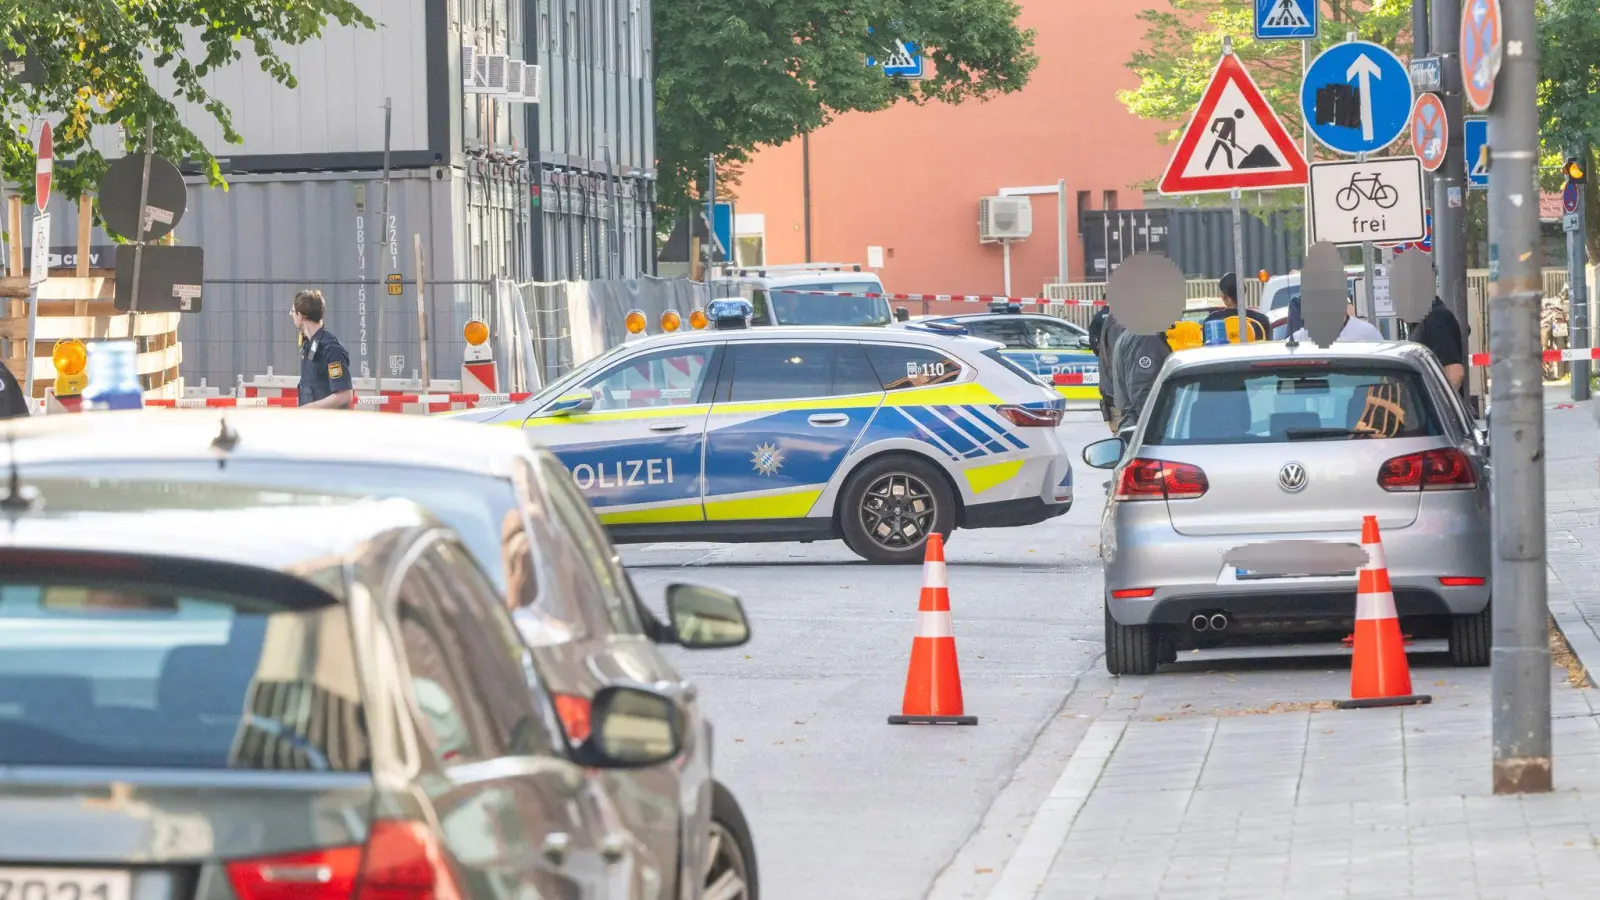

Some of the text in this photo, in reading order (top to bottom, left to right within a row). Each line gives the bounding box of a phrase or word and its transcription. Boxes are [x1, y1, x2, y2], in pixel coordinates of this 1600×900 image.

[1352, 214, 1386, 234] frei
[922, 362, 945, 376] 110
[572, 457, 674, 490] OLIZEI
